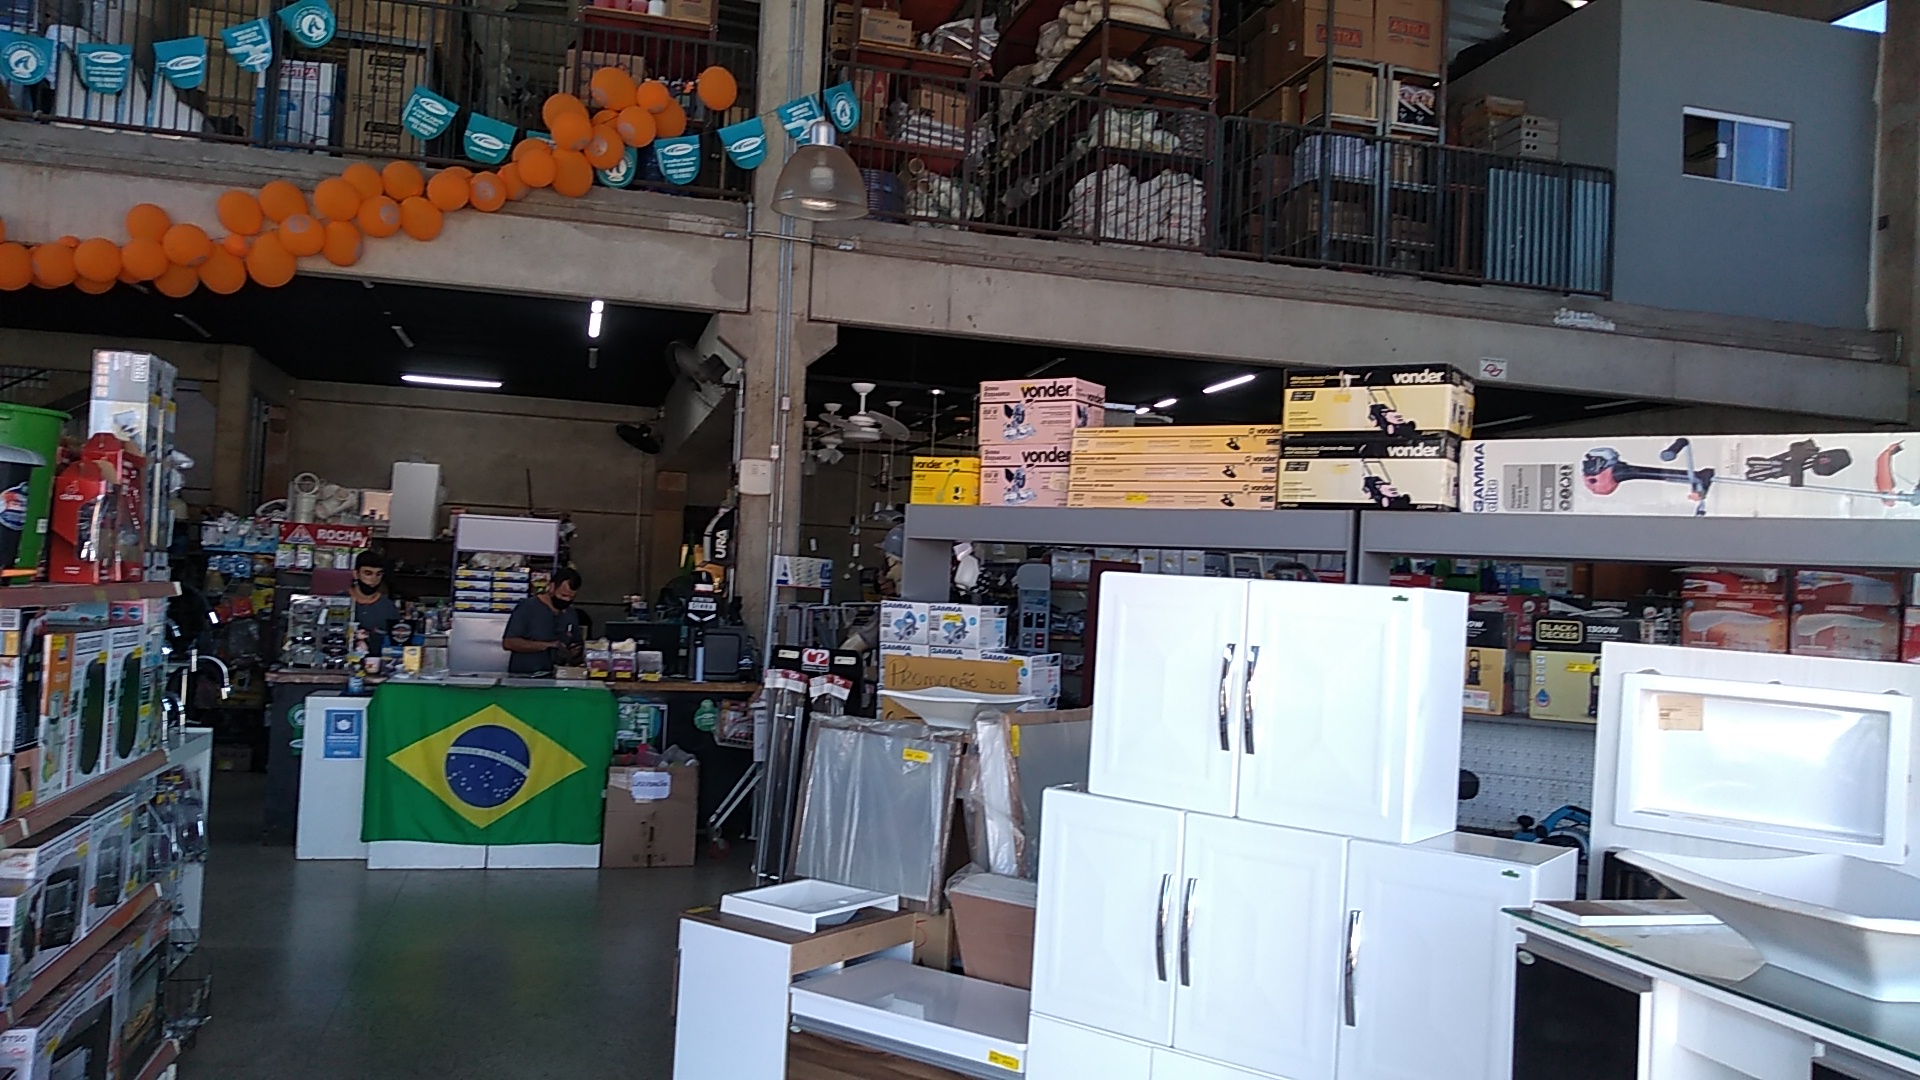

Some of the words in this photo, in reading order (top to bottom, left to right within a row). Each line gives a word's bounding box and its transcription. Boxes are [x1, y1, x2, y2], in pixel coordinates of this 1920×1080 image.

[1318, 27, 1361, 44] ATRA
[1392, 368, 1445, 384] vonder
[1021, 381, 1073, 398] vonder
[1022, 446, 1071, 463] vonder
[1387, 441, 1440, 457] vonder
[1473, 443, 1485, 512] GAMMA
[317, 529, 362, 542] ROCHA
[1540, 631, 1579, 639] DECKER
